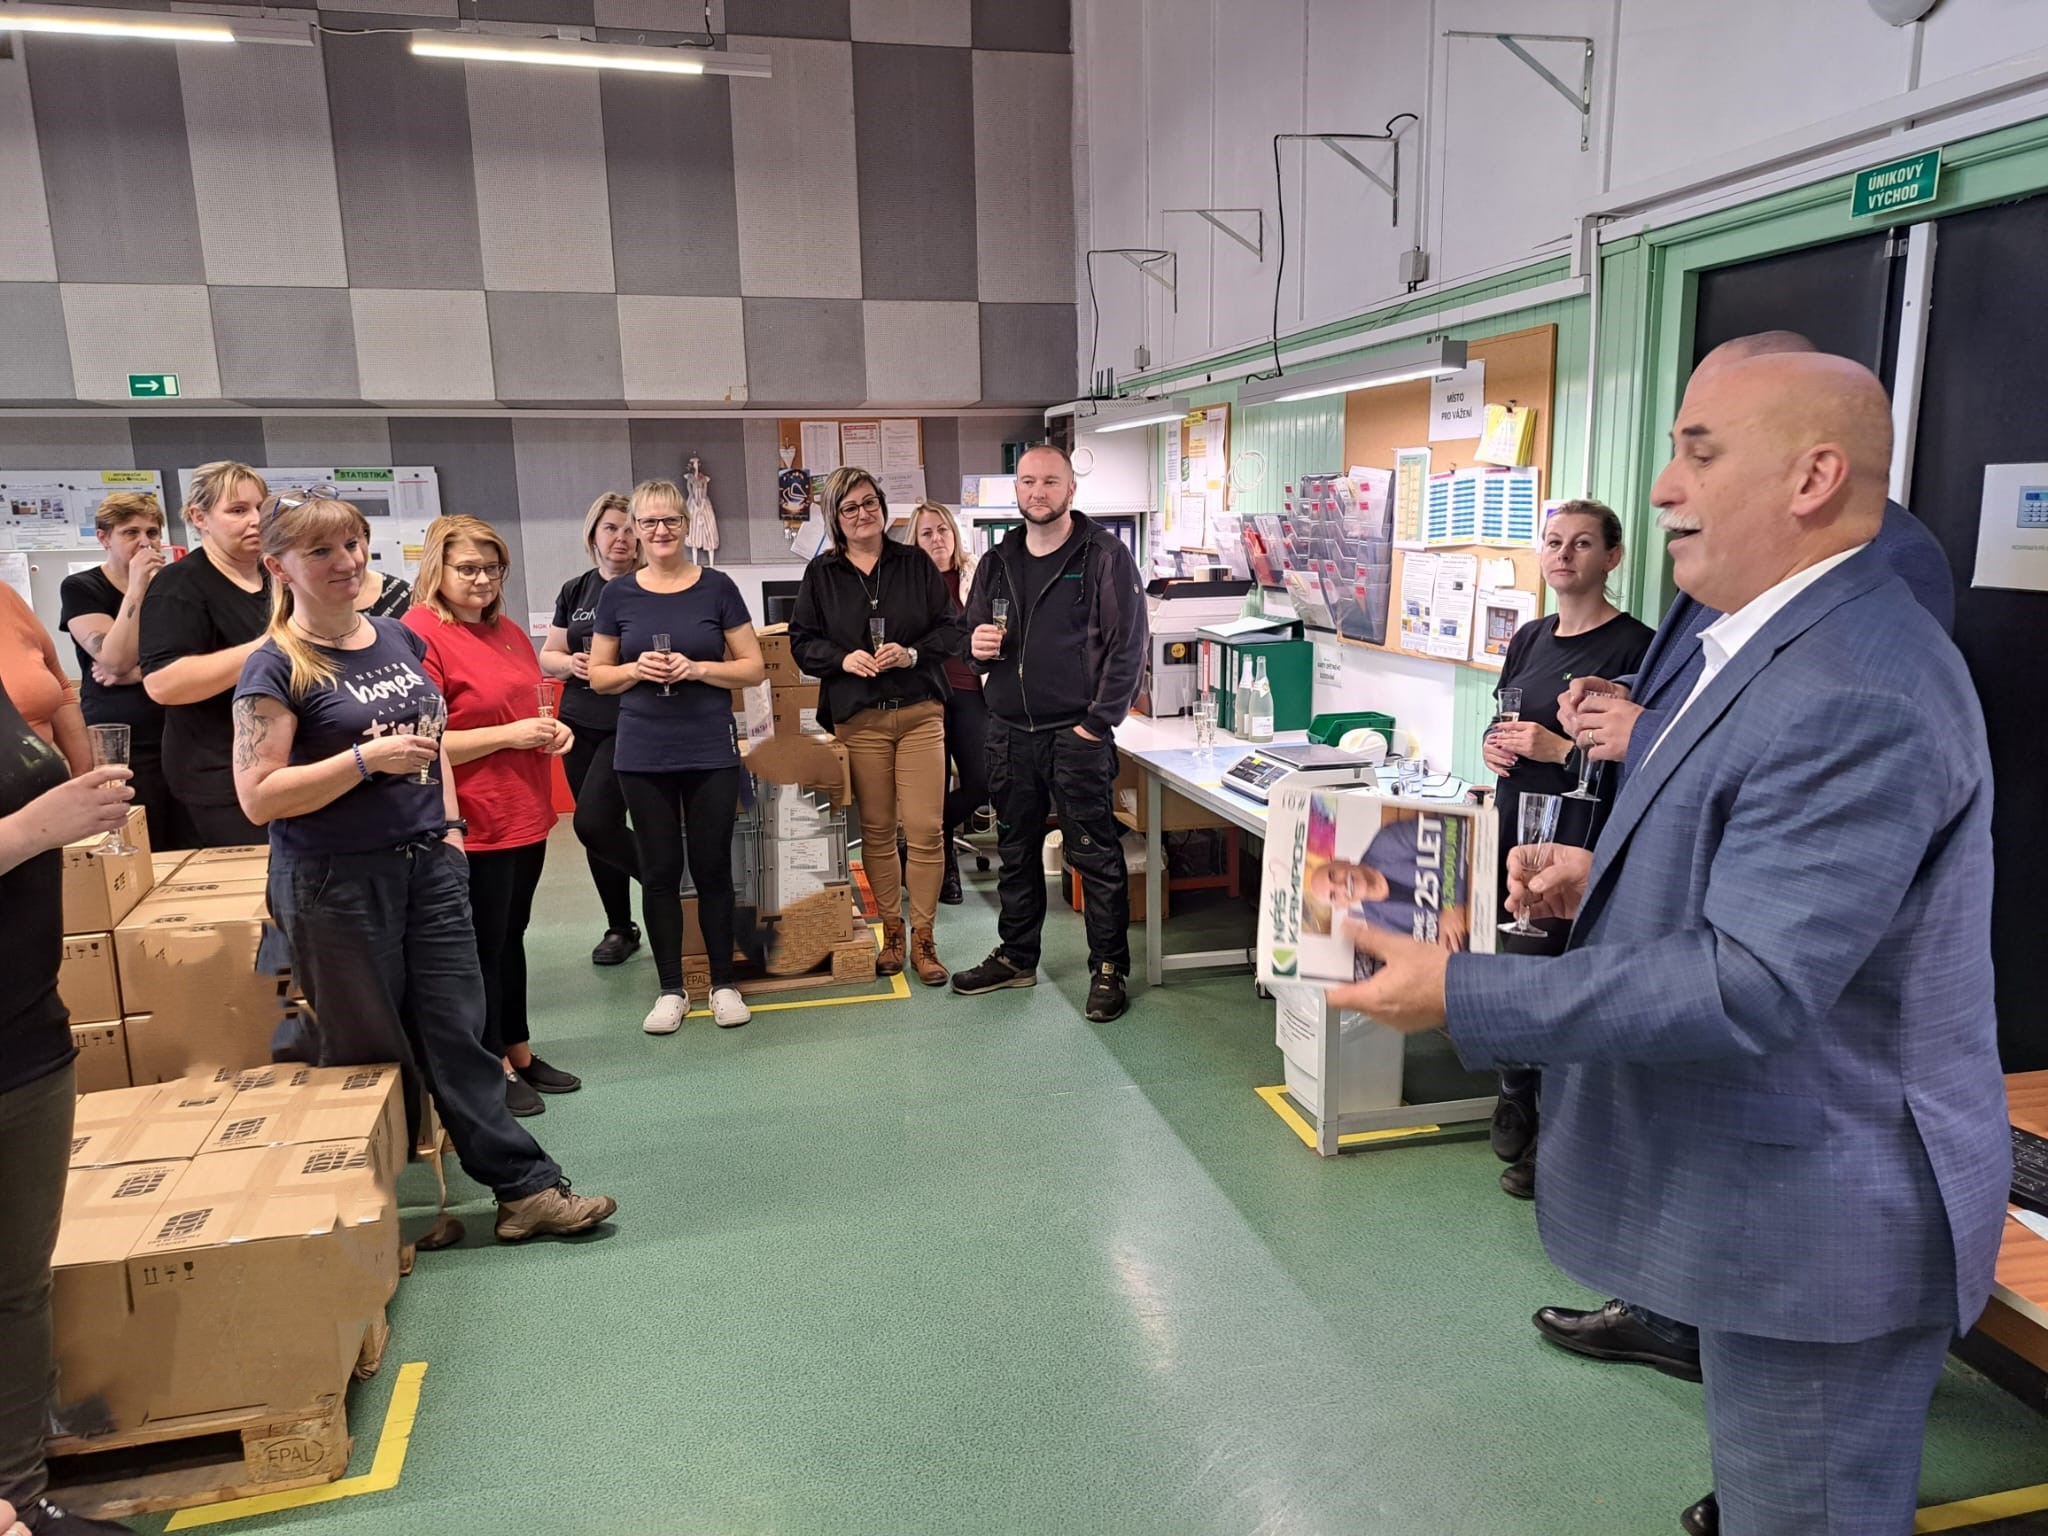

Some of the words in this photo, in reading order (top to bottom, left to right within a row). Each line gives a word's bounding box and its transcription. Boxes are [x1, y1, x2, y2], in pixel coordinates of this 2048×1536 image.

[1868, 159, 1924, 191] ÚNIKOVÝ
[1868, 184, 1919, 209] VÝCHOD
[1447, 392, 1464, 403] MÍSTO
[1441, 411, 1451, 420] PRO
[1452, 406, 1472, 419] VÁŽENÍ
[340, 471, 388, 479] STATISTIKA
[344, 662, 425, 704] bored
[355, 663, 400, 681] NEVER
[1416, 811, 1443, 870] LET
[1288, 820, 1306, 944] KAMPOS
[1415, 869, 1440, 909] 25
[1270, 886, 1287, 942] NÁŠ
[268, 1443, 315, 1464] EPAL
